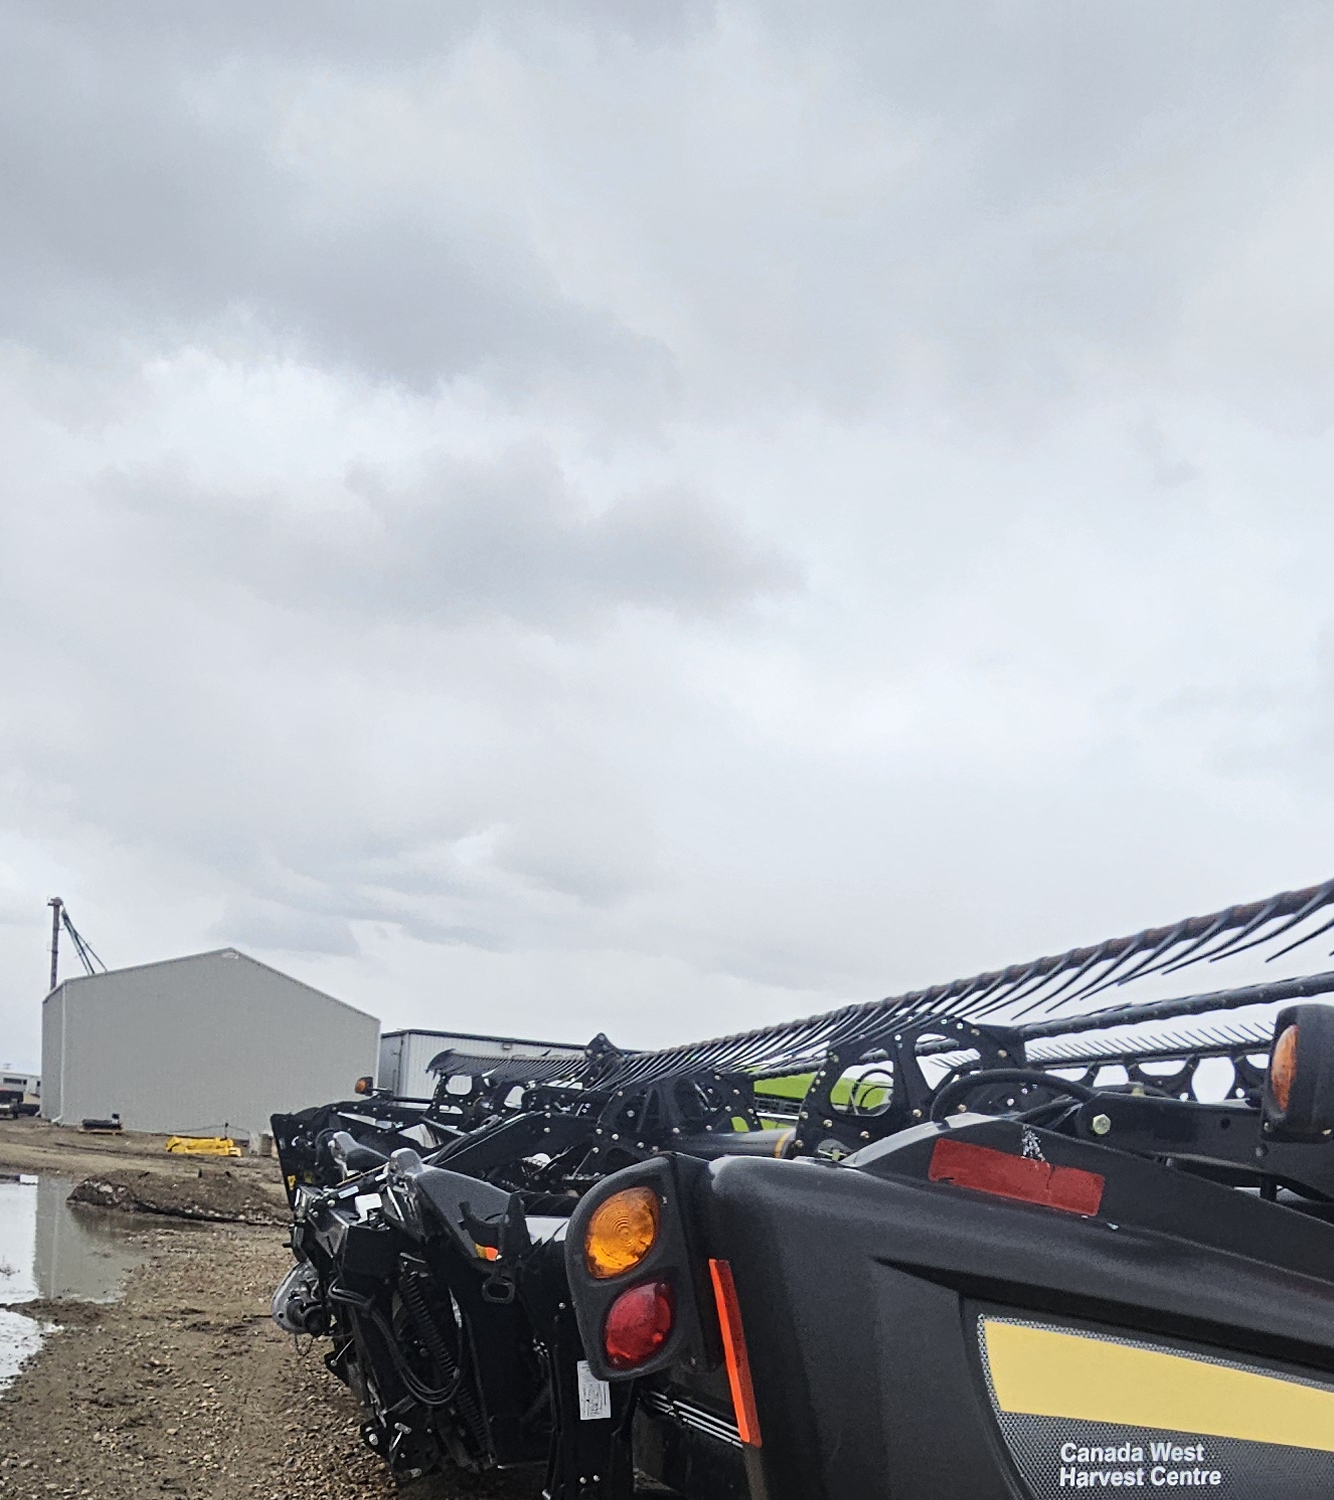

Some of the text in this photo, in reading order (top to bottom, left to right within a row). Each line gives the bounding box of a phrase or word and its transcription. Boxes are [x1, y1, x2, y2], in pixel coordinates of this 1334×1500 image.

[1060, 1442, 1205, 1463] Canada West
[1059, 1466, 1222, 1488] Harvest Centre
